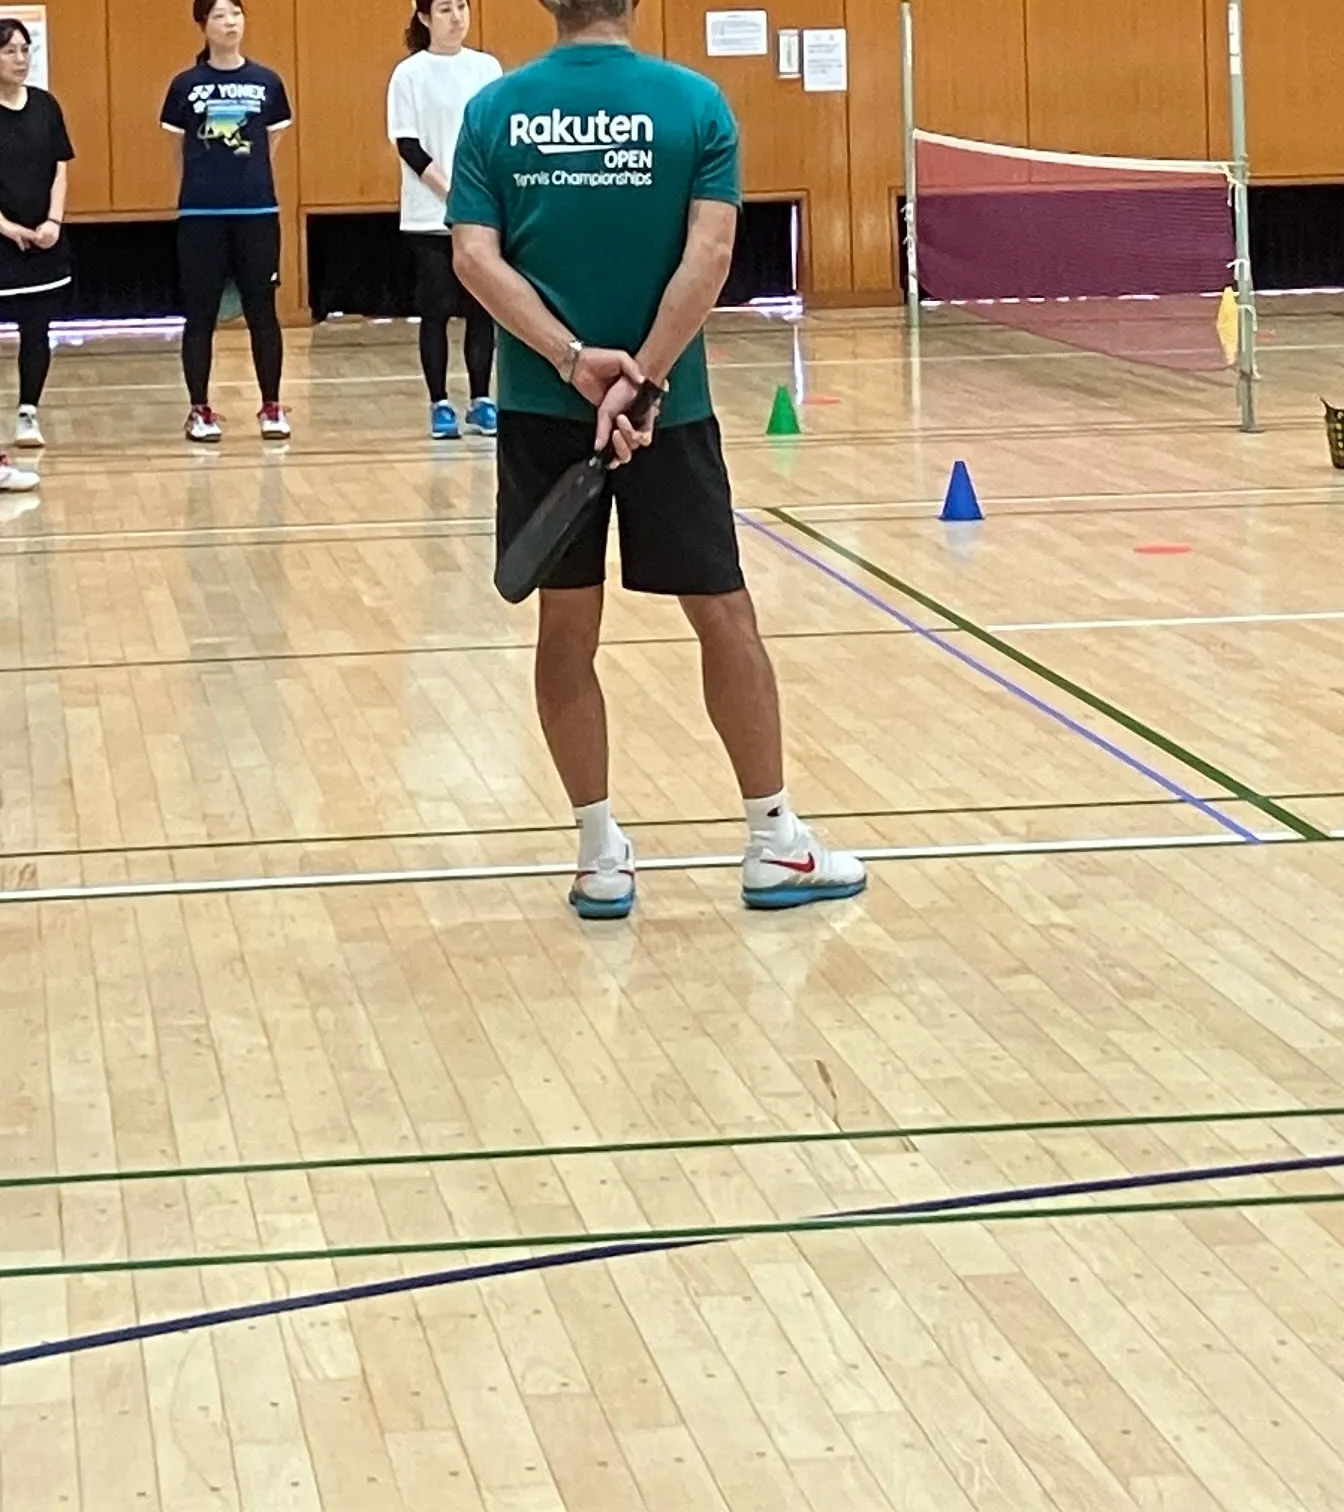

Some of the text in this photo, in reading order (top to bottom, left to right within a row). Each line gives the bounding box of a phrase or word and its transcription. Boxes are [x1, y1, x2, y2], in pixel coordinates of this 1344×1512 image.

[217, 83, 266, 101] YONEX
[510, 108, 654, 146] Rakuten
[604, 149, 653, 169] OPEN
[551, 170, 652, 187] Championships
